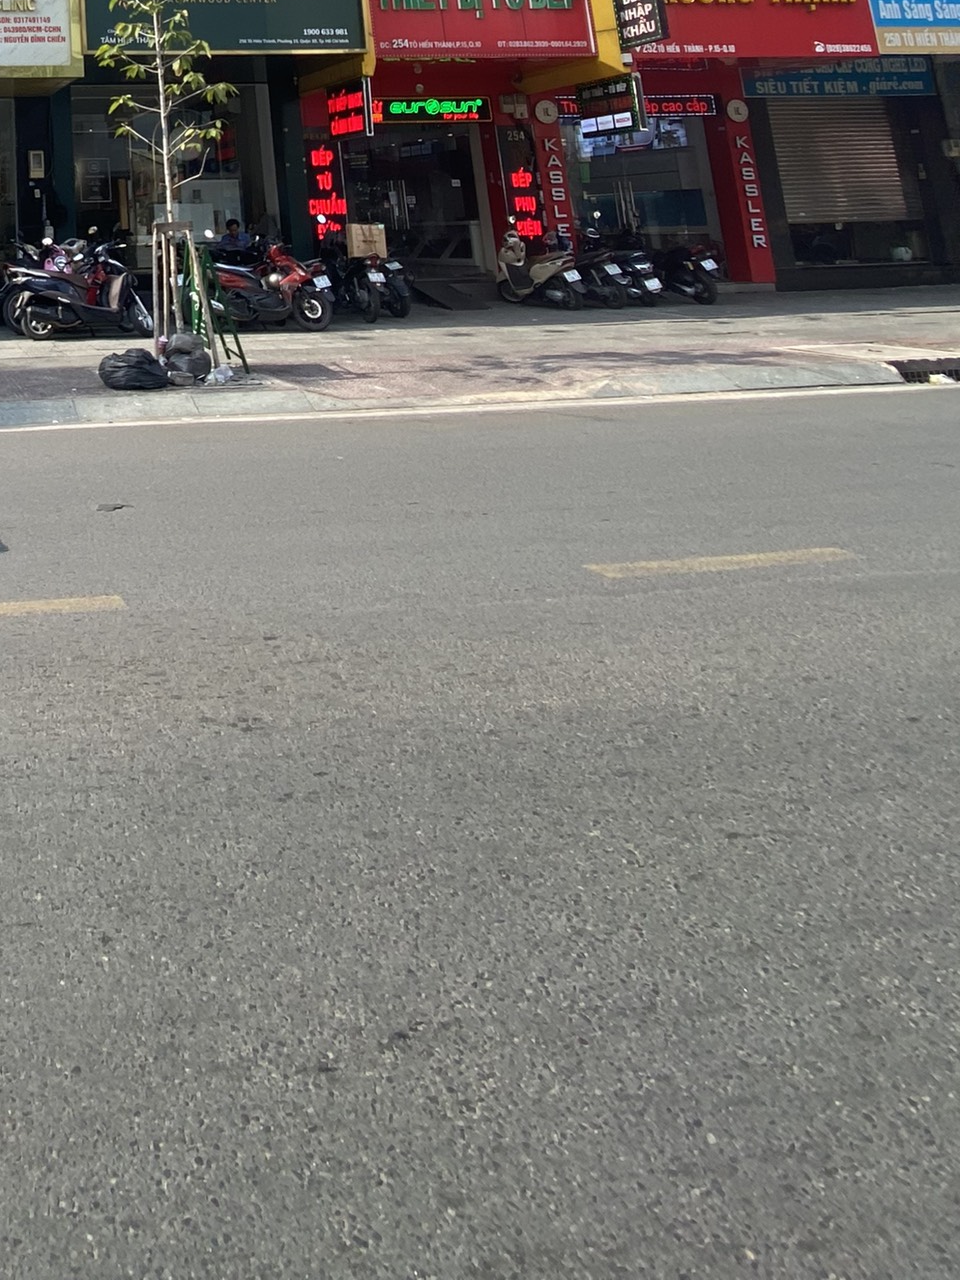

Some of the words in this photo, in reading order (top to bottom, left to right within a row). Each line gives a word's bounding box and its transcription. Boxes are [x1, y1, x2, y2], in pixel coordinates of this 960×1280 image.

[303, 28, 320, 36] 1900
[392, 39, 409, 49] 254
[642, 42, 657, 53] 252
[755, 78, 787, 95] SIÊU
[789, 77, 819, 94] TIẾT
[824, 78, 859, 96] KIỆM
[662, 102, 683, 113] cao
[507, 130, 525, 141] 254
[311, 144, 333, 166] BẾP
[511, 166, 533, 188] BẾP
[735, 135, 768, 248] KASSLER
[514, 196, 536, 216] PHỤ
